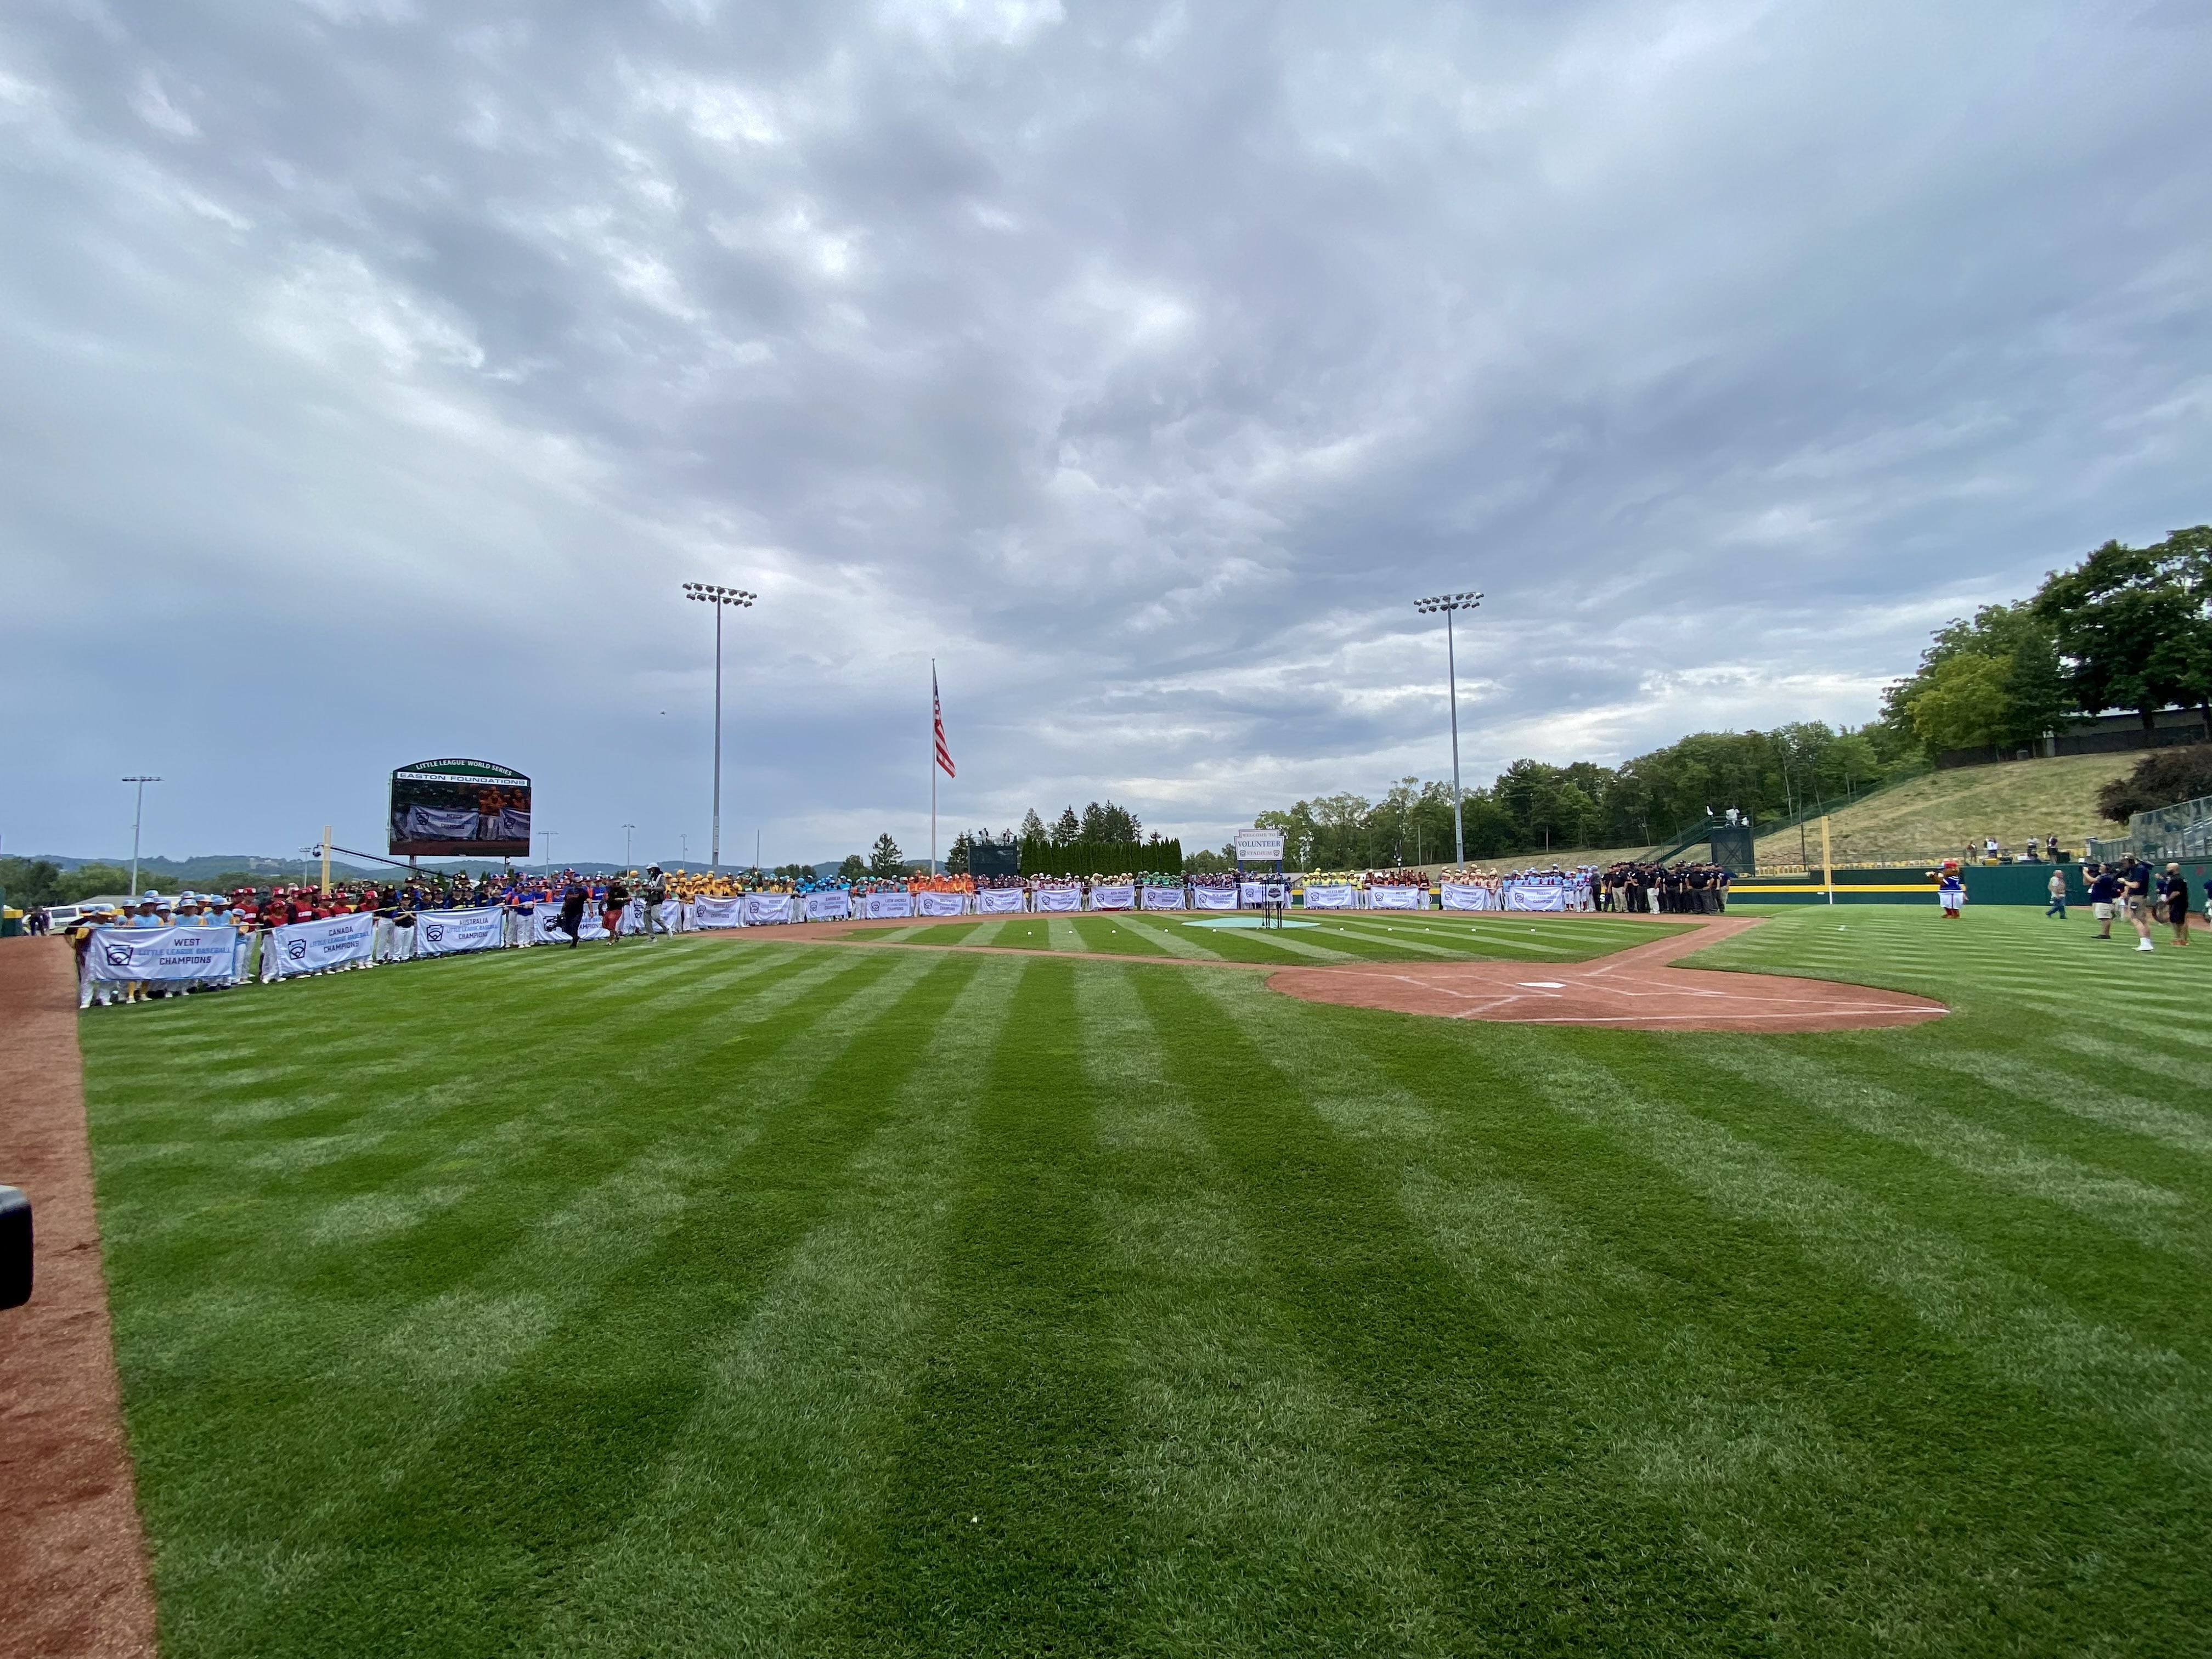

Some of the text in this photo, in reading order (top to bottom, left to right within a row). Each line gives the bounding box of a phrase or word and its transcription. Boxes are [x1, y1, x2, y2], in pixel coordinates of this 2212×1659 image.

[416, 760, 438, 770] LITTLE
[467, 760, 490, 769] WORLD
[492, 765, 512, 776] SERIES
[450, 776, 526, 786] FOUNDATIONS
[459, 917, 489, 926] AUSTRALIA
[328, 926, 353, 936] CANADA
[458, 930, 489, 940] CHAMPIONS
[174, 938, 201, 946] WEST
[323, 940, 359, 953] CHAMPIONS
[159, 956, 212, 966] CHAMPIONS
